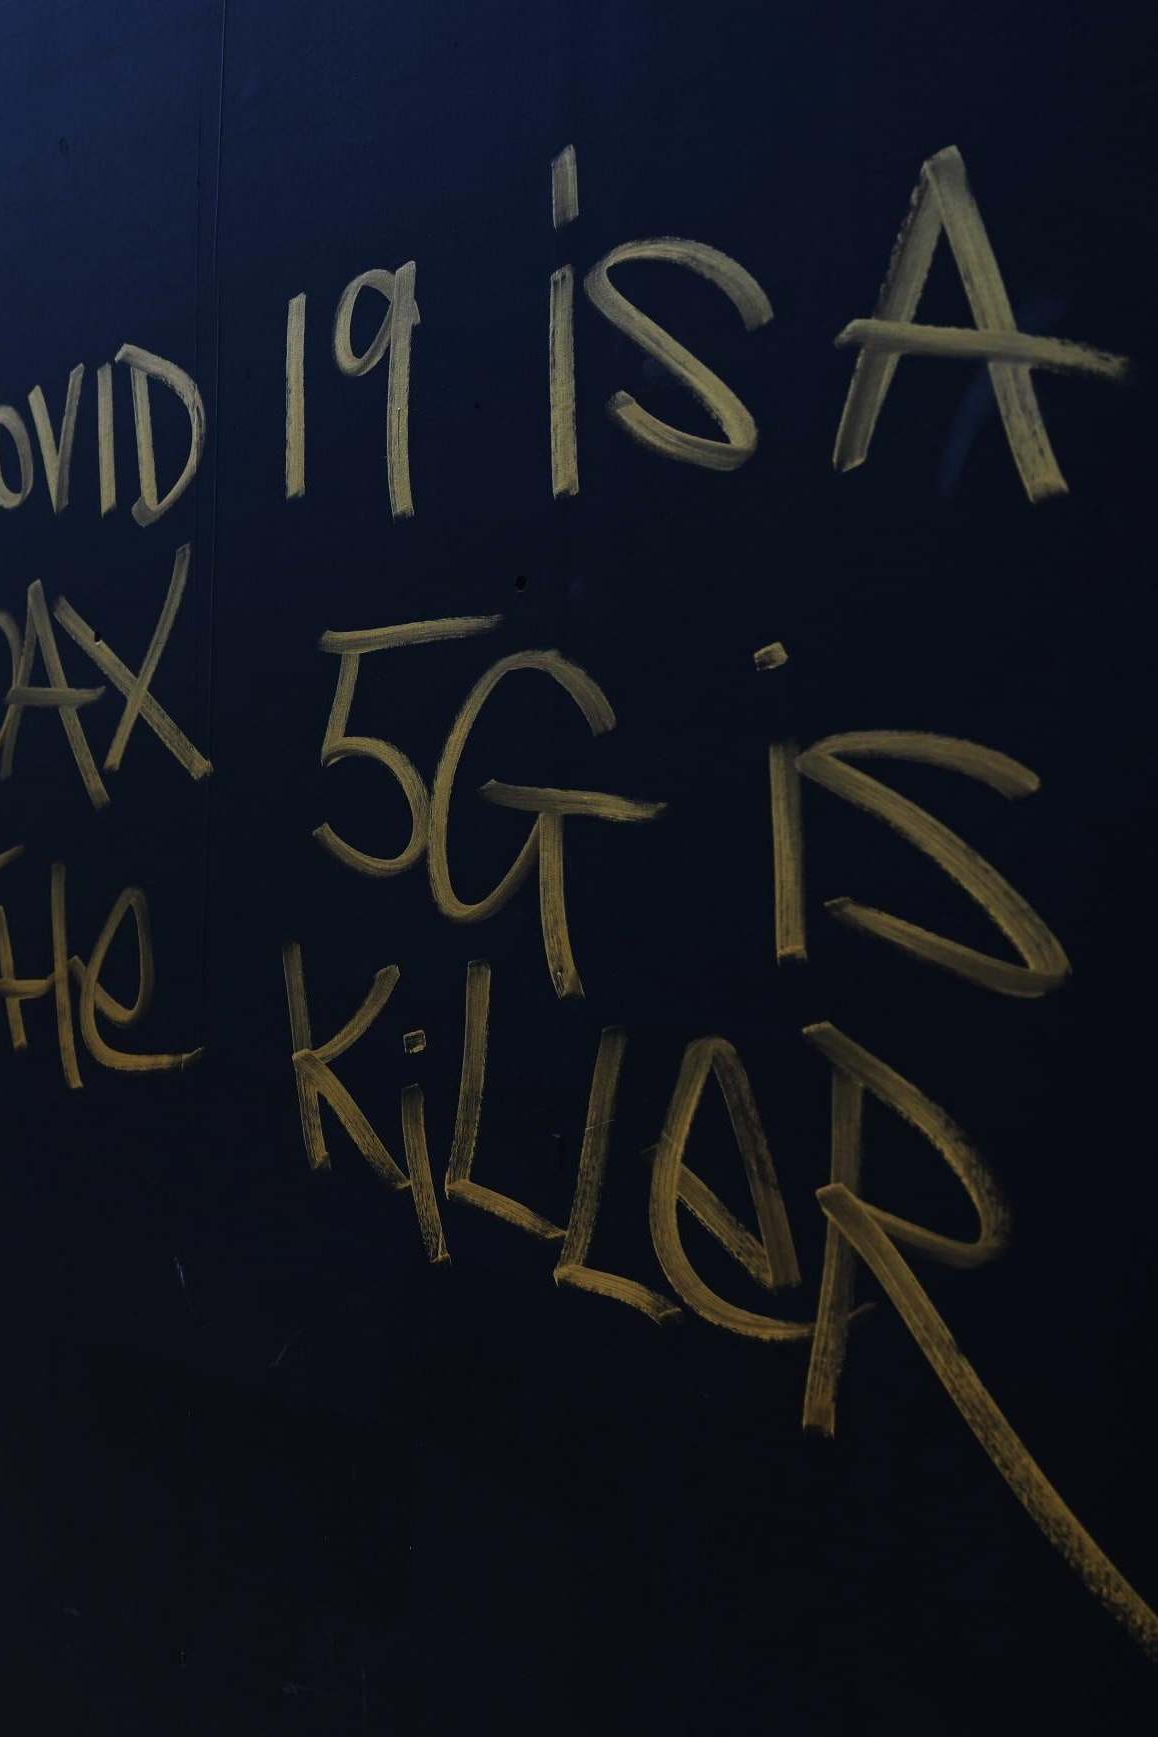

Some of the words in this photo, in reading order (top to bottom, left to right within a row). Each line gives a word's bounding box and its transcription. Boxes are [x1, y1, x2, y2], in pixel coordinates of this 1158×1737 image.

[285, 260, 421, 517] 19
[832, 145, 1126, 503] A
[312, 614, 667, 999] 5G
